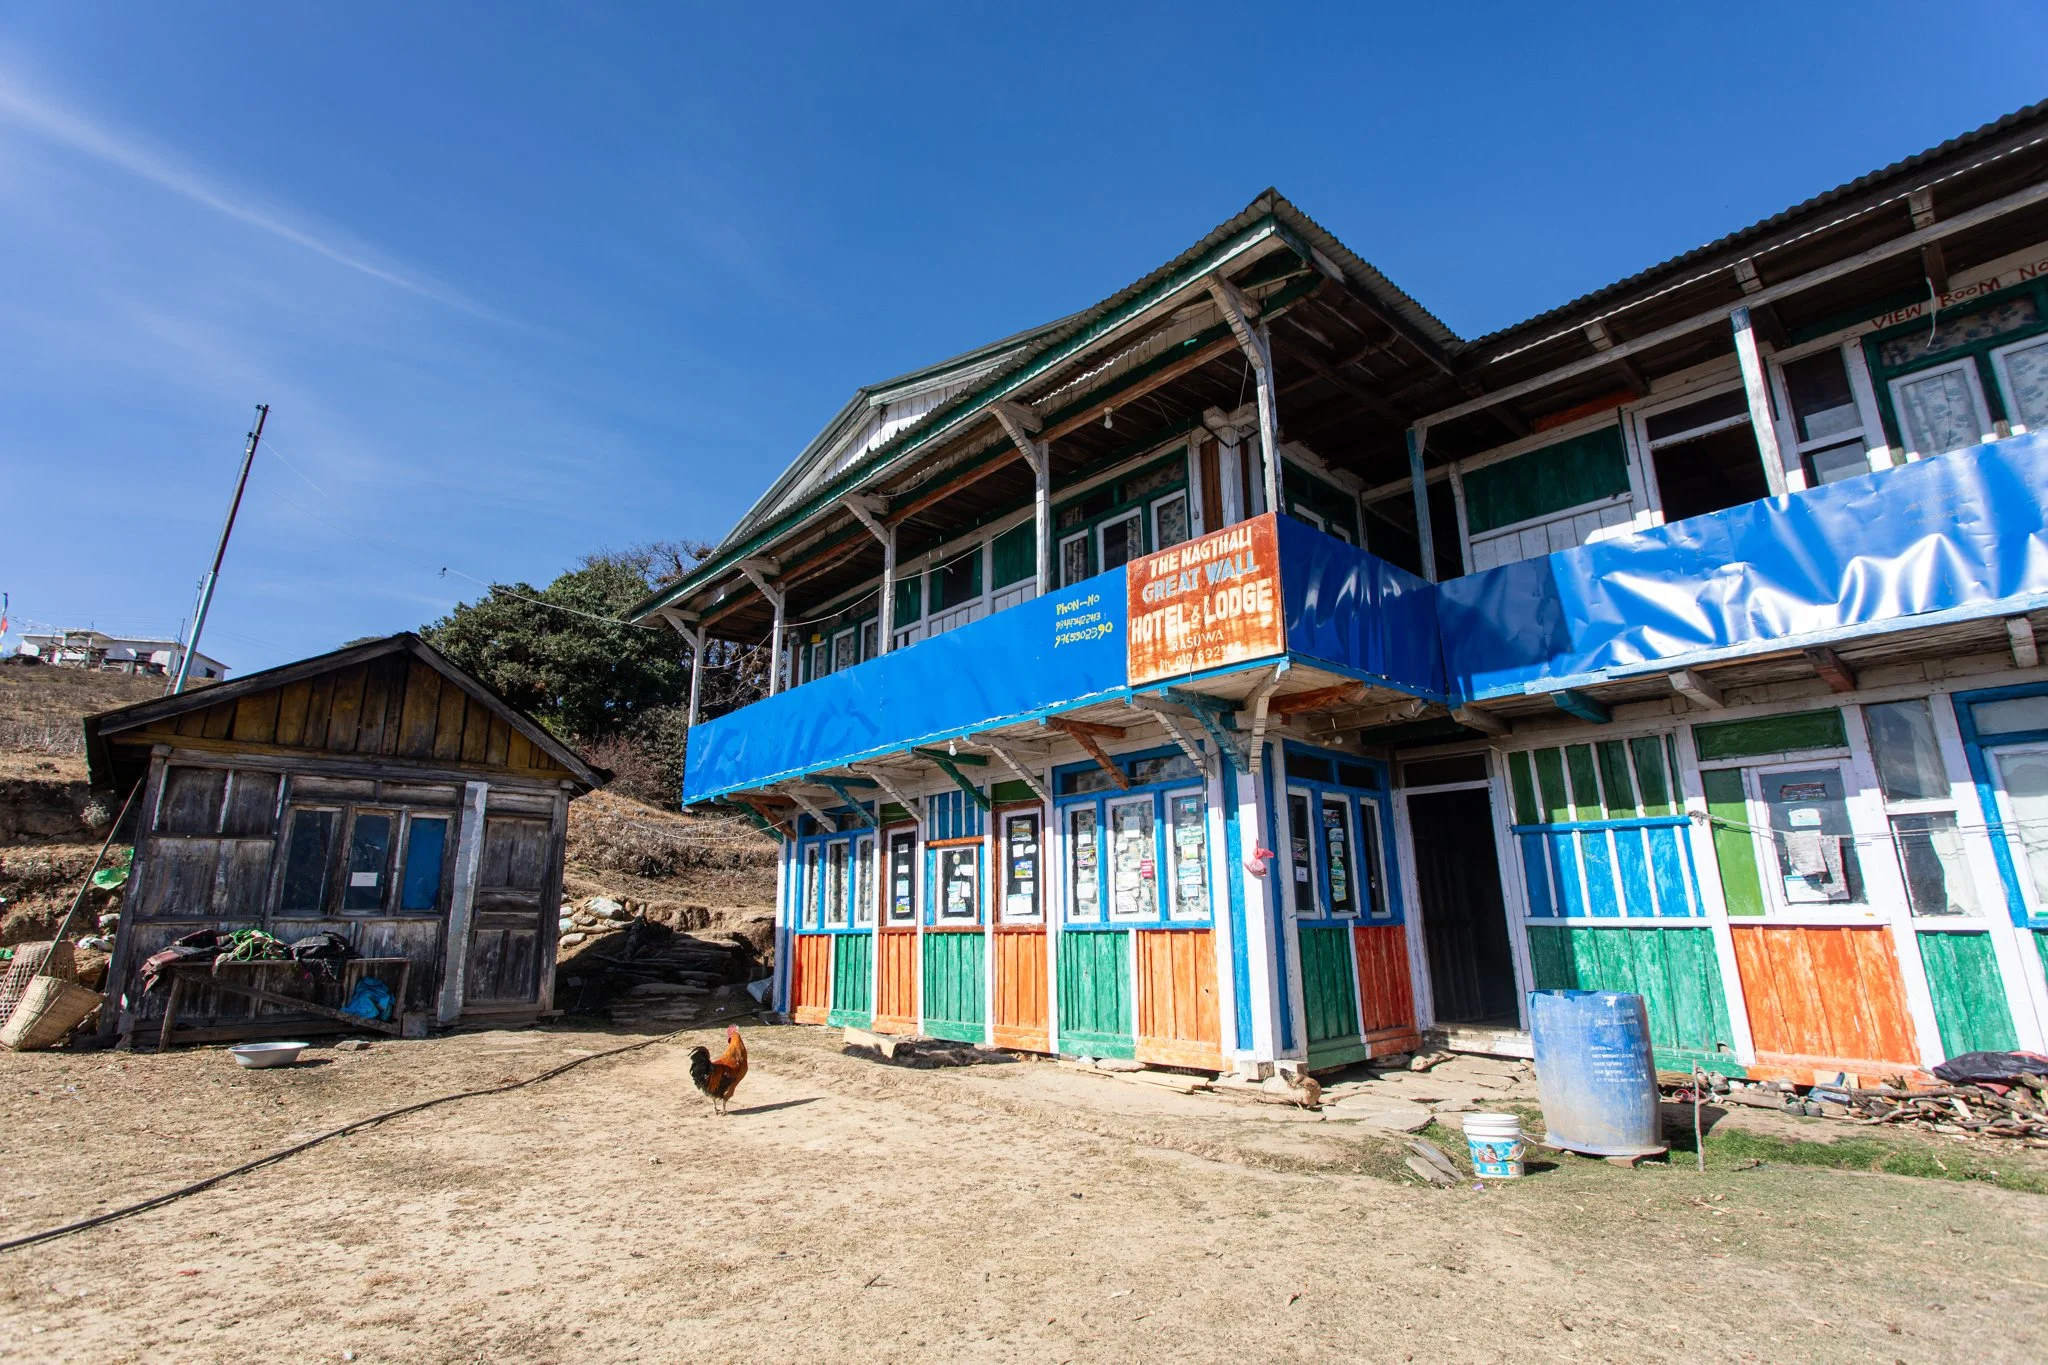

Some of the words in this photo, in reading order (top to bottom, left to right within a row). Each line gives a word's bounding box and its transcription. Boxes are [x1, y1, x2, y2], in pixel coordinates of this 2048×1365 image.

[1872, 304, 1921, 330] VIEW
[1142, 566, 1201, 604] GREAT
[1205, 550, 1260, 586] WALL
[1149, 551, 1179, 579] THE
[1181, 525, 1252, 568] NAGTHALI
[1131, 603, 1190, 645] HOTEL
[1190, 604, 1201, 624] &
[1203, 577, 1273, 626] LODGE
[1172, 629, 1224, 652] RASUWA
